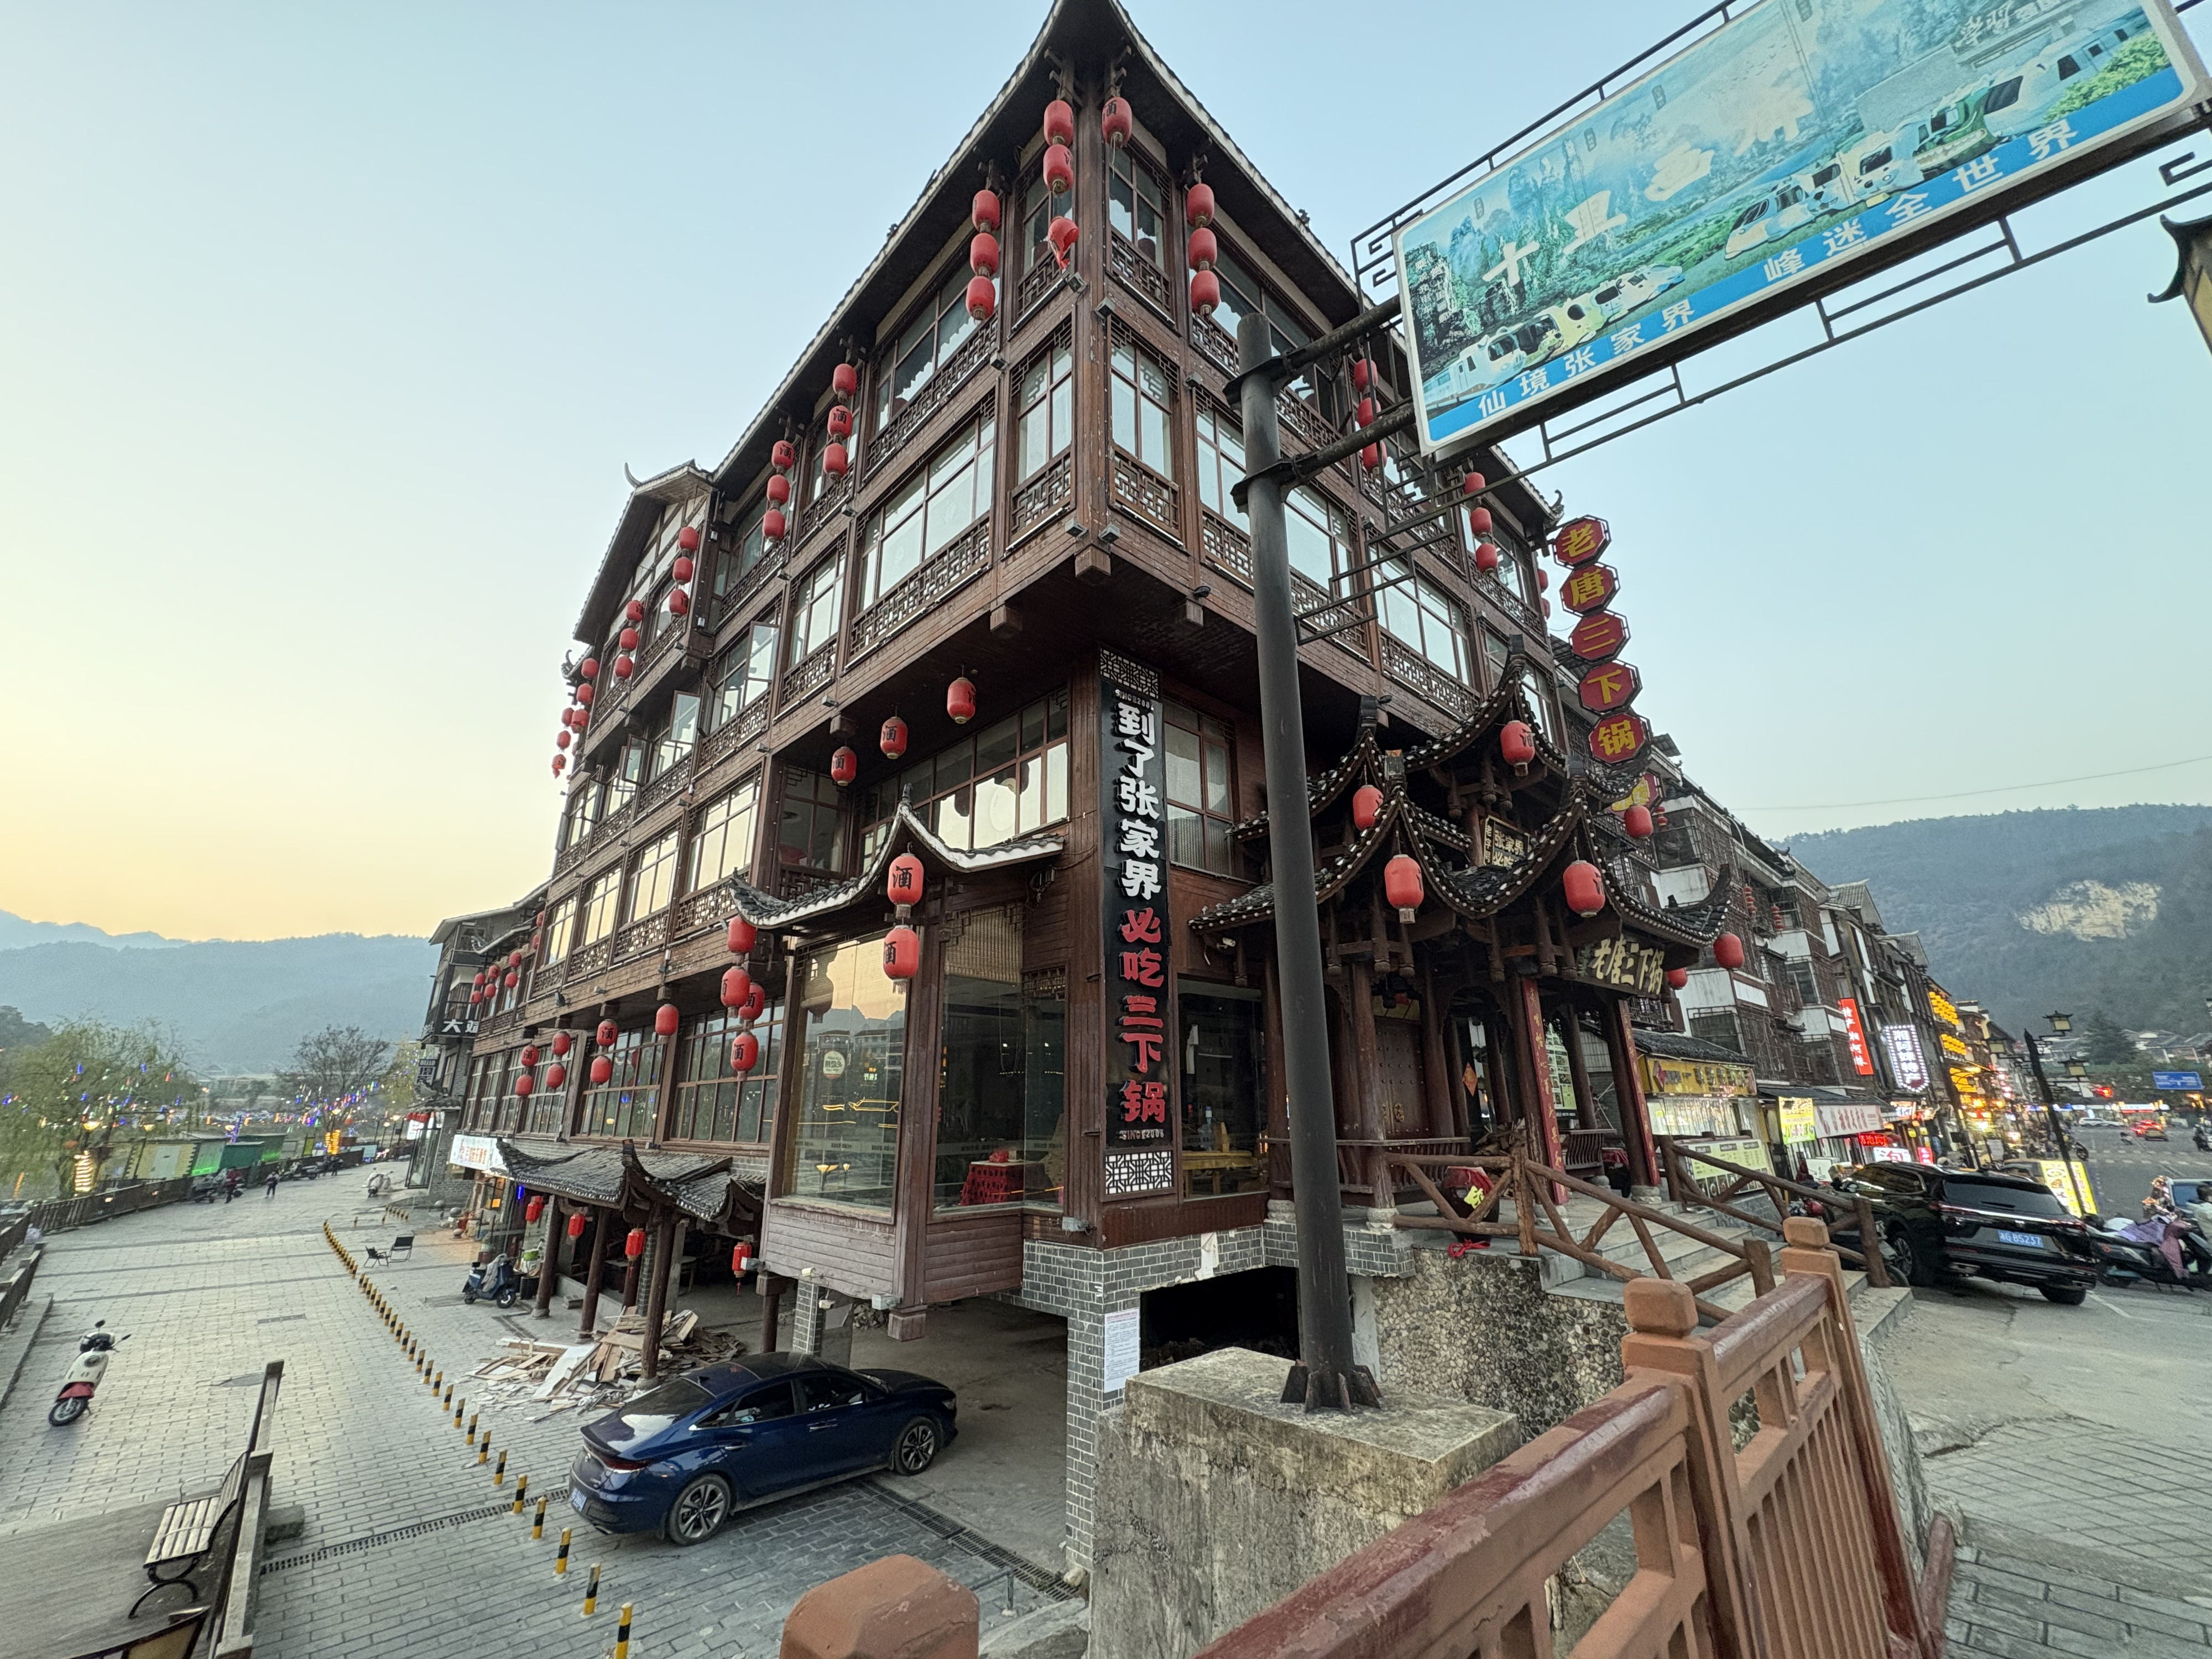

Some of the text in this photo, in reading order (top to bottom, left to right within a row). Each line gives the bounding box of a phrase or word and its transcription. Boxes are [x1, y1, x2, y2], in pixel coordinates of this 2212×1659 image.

[1478, 119, 2078, 418] 仙境张家界 峰迷全世界
[833, 408, 848, 424] 酒
[780, 443, 791, 460] 酒
[1561, 523, 1637, 755] 老唐三下锅
[883, 725, 898, 742] 酒
[1494, 830, 1524, 855] 张家界
[1493, 851, 1520, 867] 必吃
[893, 865, 912, 890] 酒
[1593, 933, 1665, 995] 老唐三下锅
[732, 1044, 745, 1061] 酒
